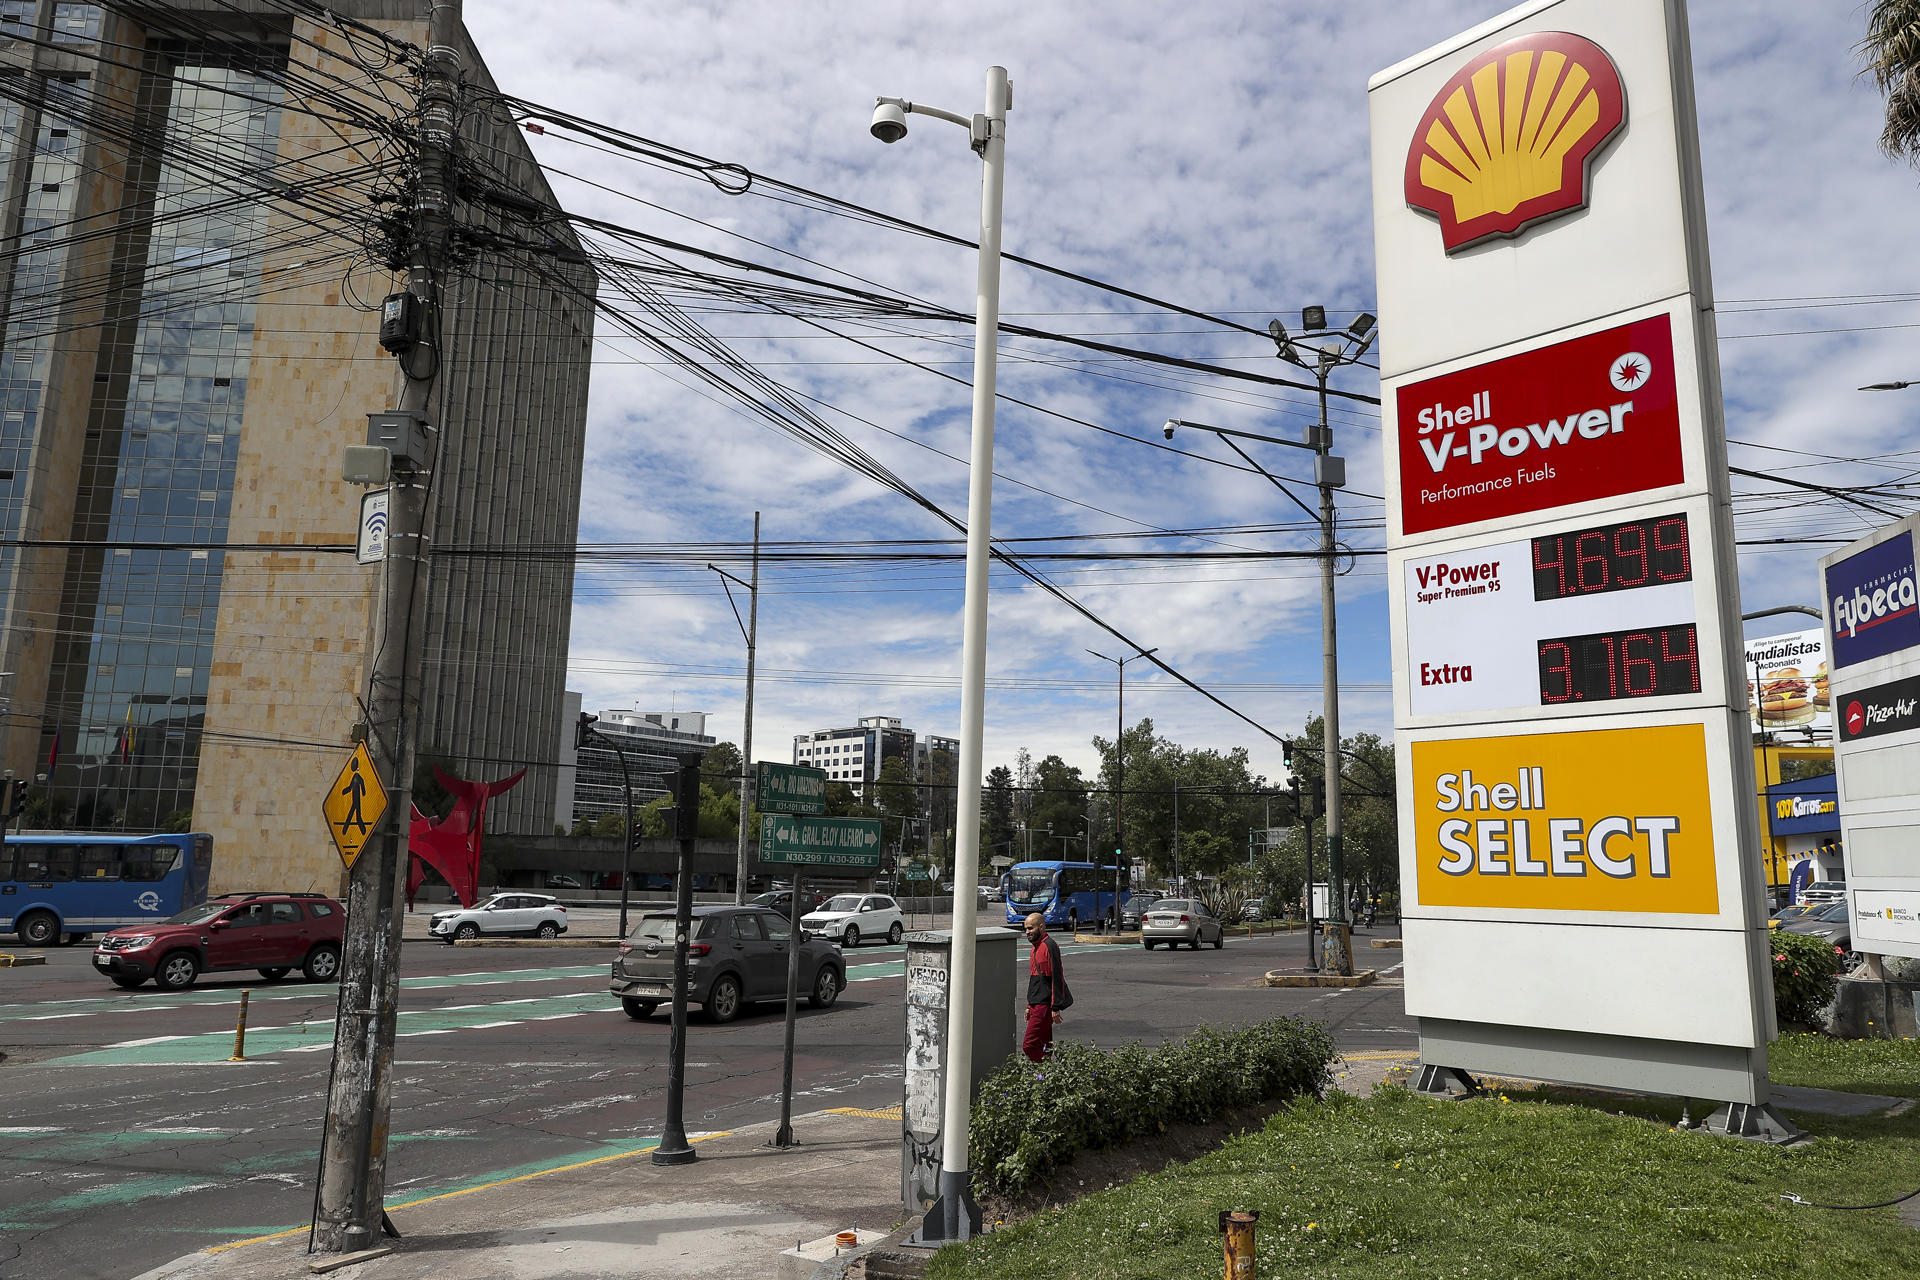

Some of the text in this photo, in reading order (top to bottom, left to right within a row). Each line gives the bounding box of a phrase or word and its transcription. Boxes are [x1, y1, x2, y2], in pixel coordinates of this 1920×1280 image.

[1418, 390, 1491, 434] Shell
[1418, 400, 1634, 473] V-Power
[1421, 463, 1556, 504] Performance Fuels
[1416, 560, 1500, 589] V-Power
[1533, 518, 1690, 596] 4.699
[1417, 579, 1501, 605] Super Premium 95
[1420, 662, 1472, 686] Extra
[1865, 698, 1918, 726] Pizza Hut
[1436, 767, 1545, 812] Shell
[839, 828, 864, 848] ALFARO
[1437, 815, 1680, 879] SELECT
[786, 853, 822, 863] N30-299
[829, 855, 865, 864] N30-205
